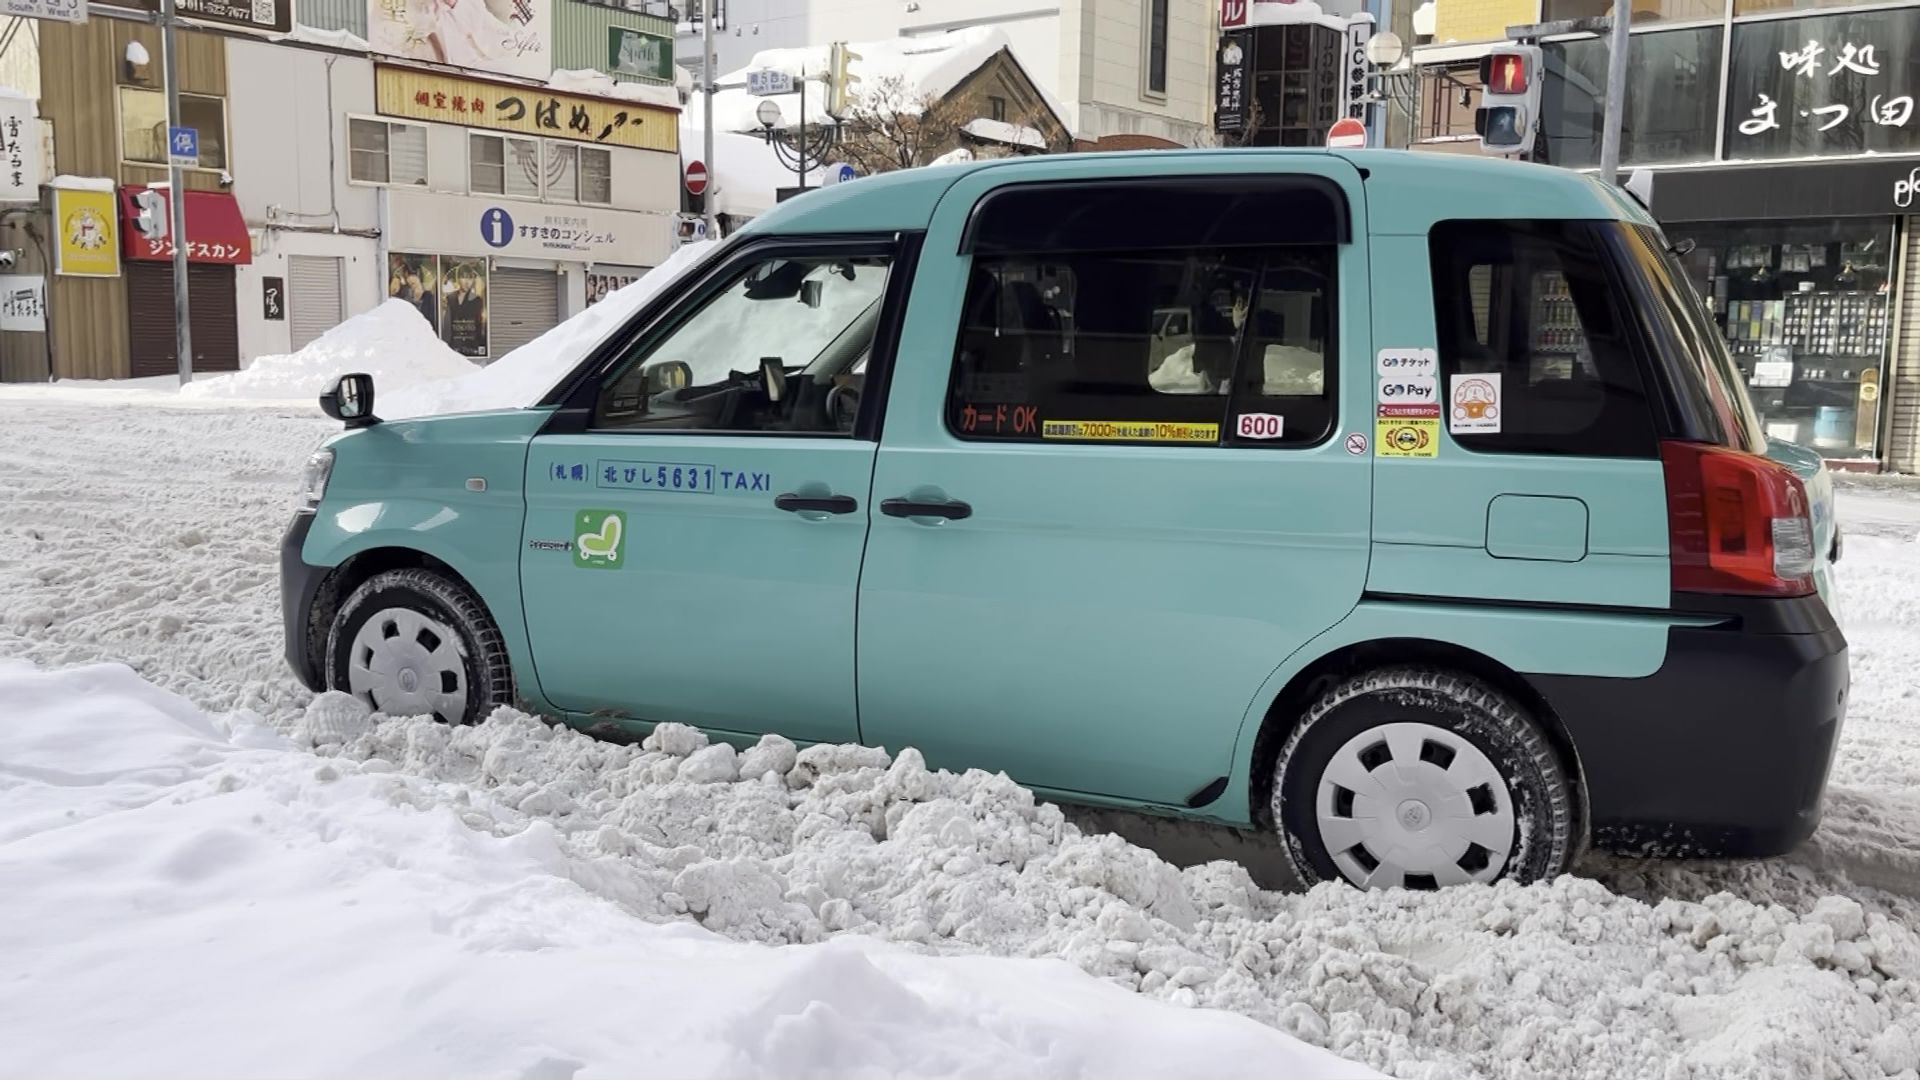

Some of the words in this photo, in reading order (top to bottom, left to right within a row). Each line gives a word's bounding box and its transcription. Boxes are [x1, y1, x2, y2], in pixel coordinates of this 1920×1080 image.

[8, 2, 34, 11] South
[47, 6, 70, 17] West
[1779, 39, 1880, 78] 味処
[415, 89, 485, 113] 個室焼肉
[1738, 93, 1914, 136] まつ田
[519, 225, 615, 243] すすきのコンシェル
[149, 239, 241, 258] ジンギスカン
[1400, 358, 1430, 367] チケット
[1383, 384, 1404, 396] GO
[1407, 384, 1432, 398] Pay
[961, 403, 1007, 432] カード
[1013, 405, 1038, 433] OK
[1240, 416, 1278, 435] 600
[720, 471, 771, 491] TAXI
